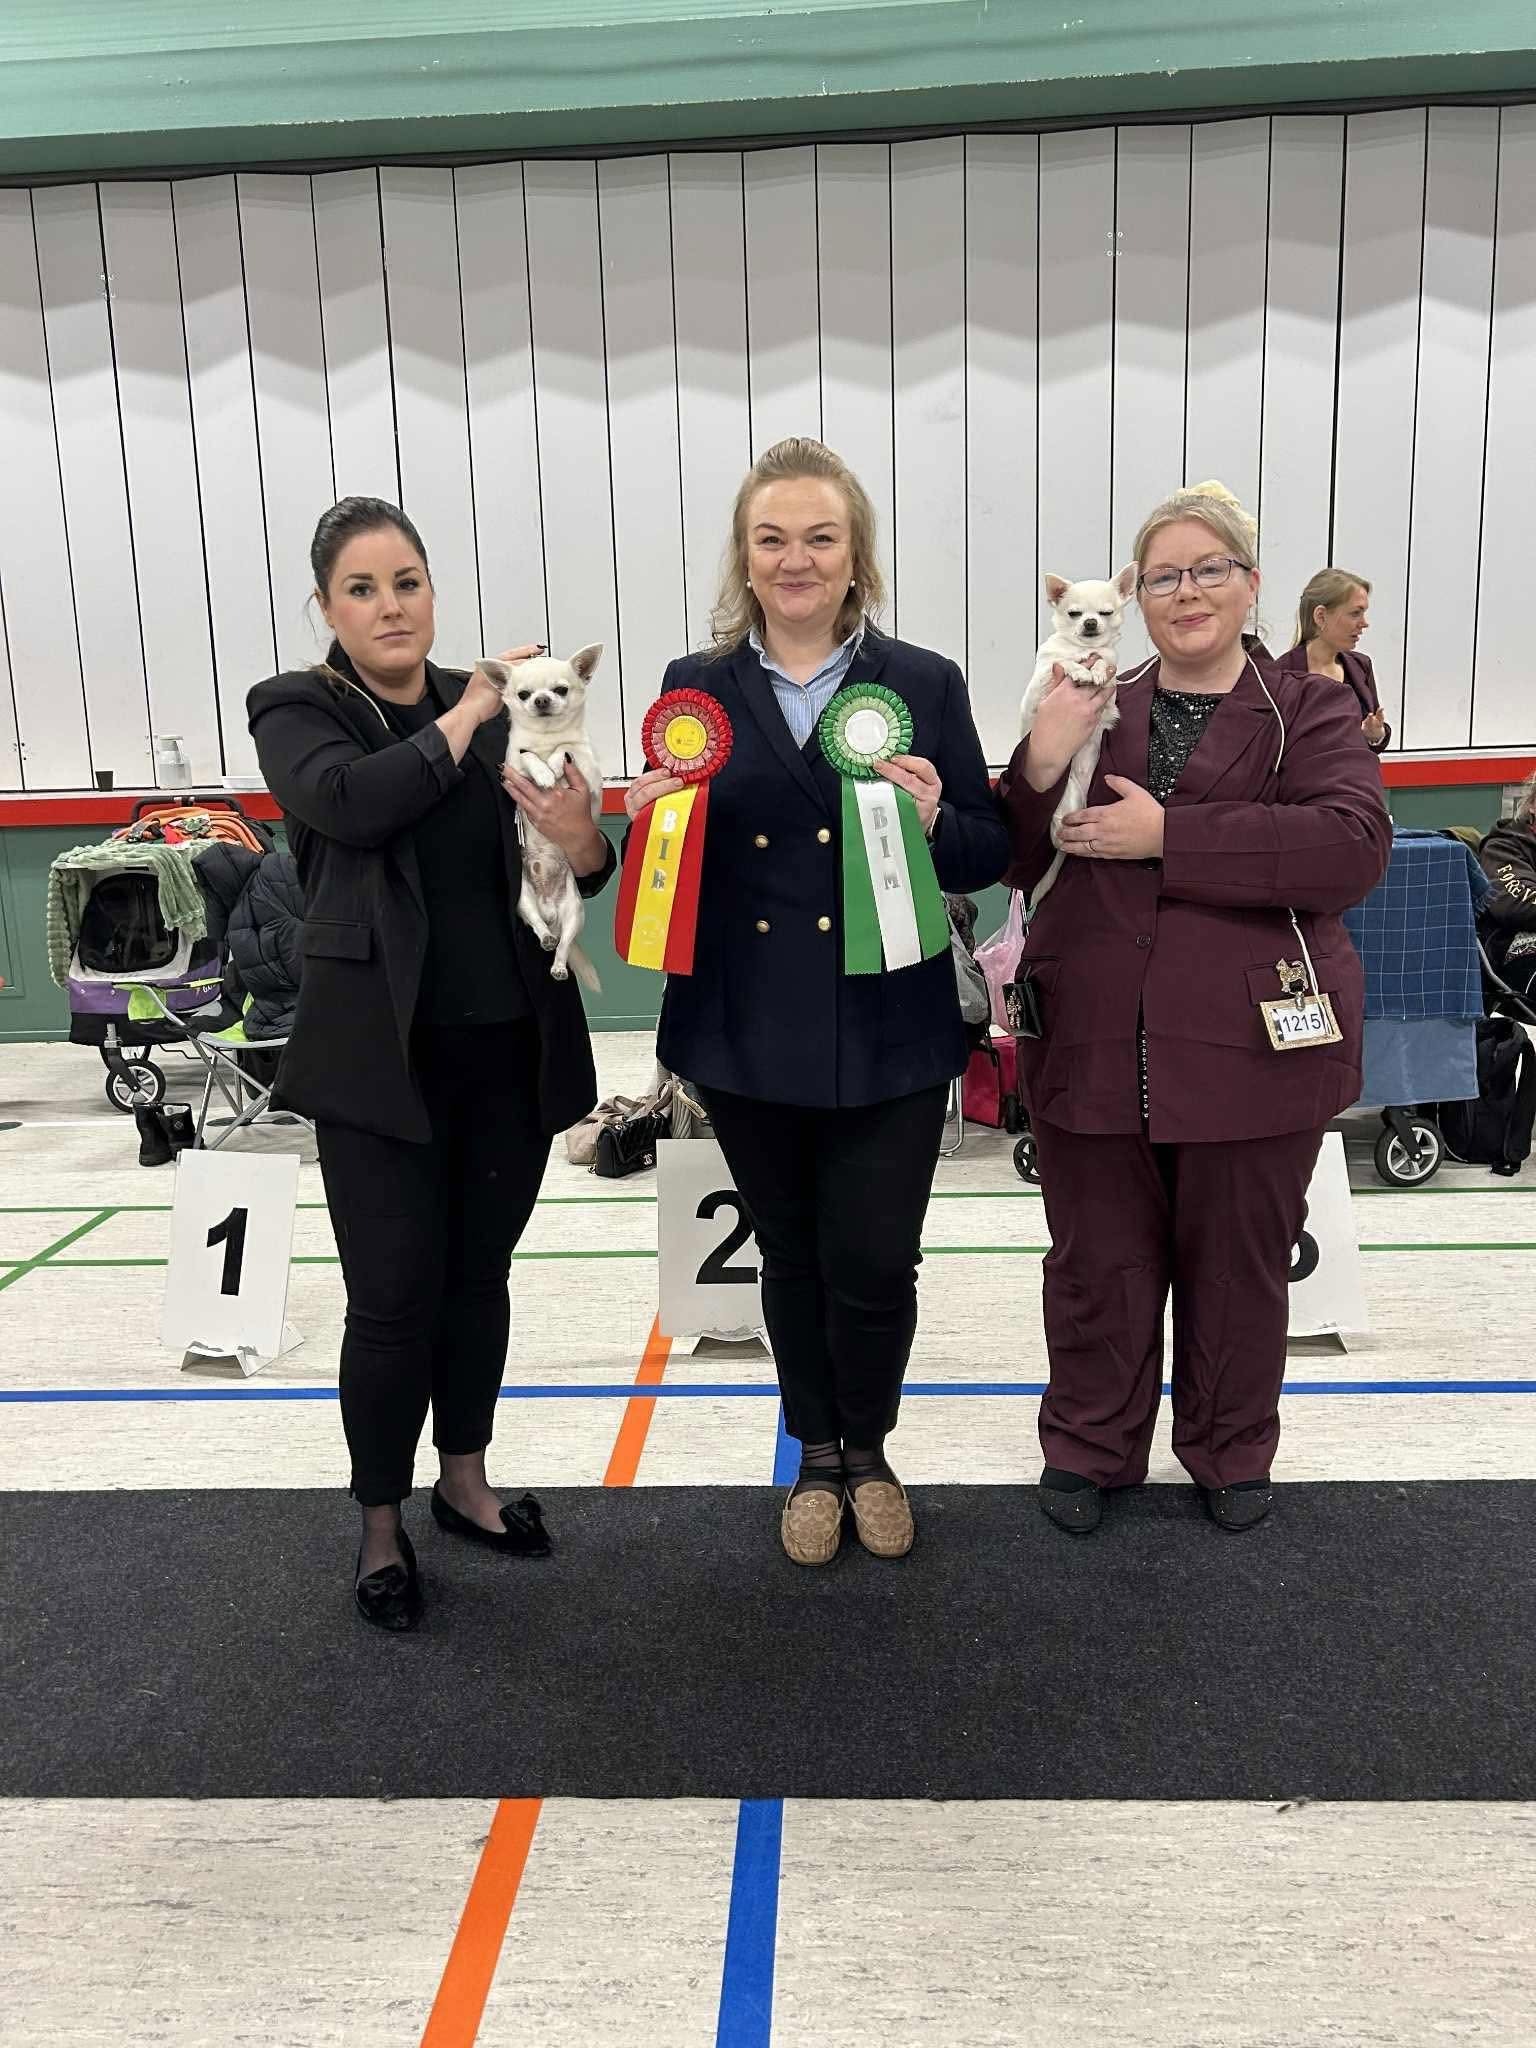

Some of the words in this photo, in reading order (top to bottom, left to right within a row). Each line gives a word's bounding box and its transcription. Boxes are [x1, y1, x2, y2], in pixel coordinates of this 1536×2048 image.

[1497, 863, 1536, 905] FOREV
[1282, 1013, 1321, 1032] 1215
[206, 1207, 248, 1296] 1
[695, 1189, 758, 1285] 2
